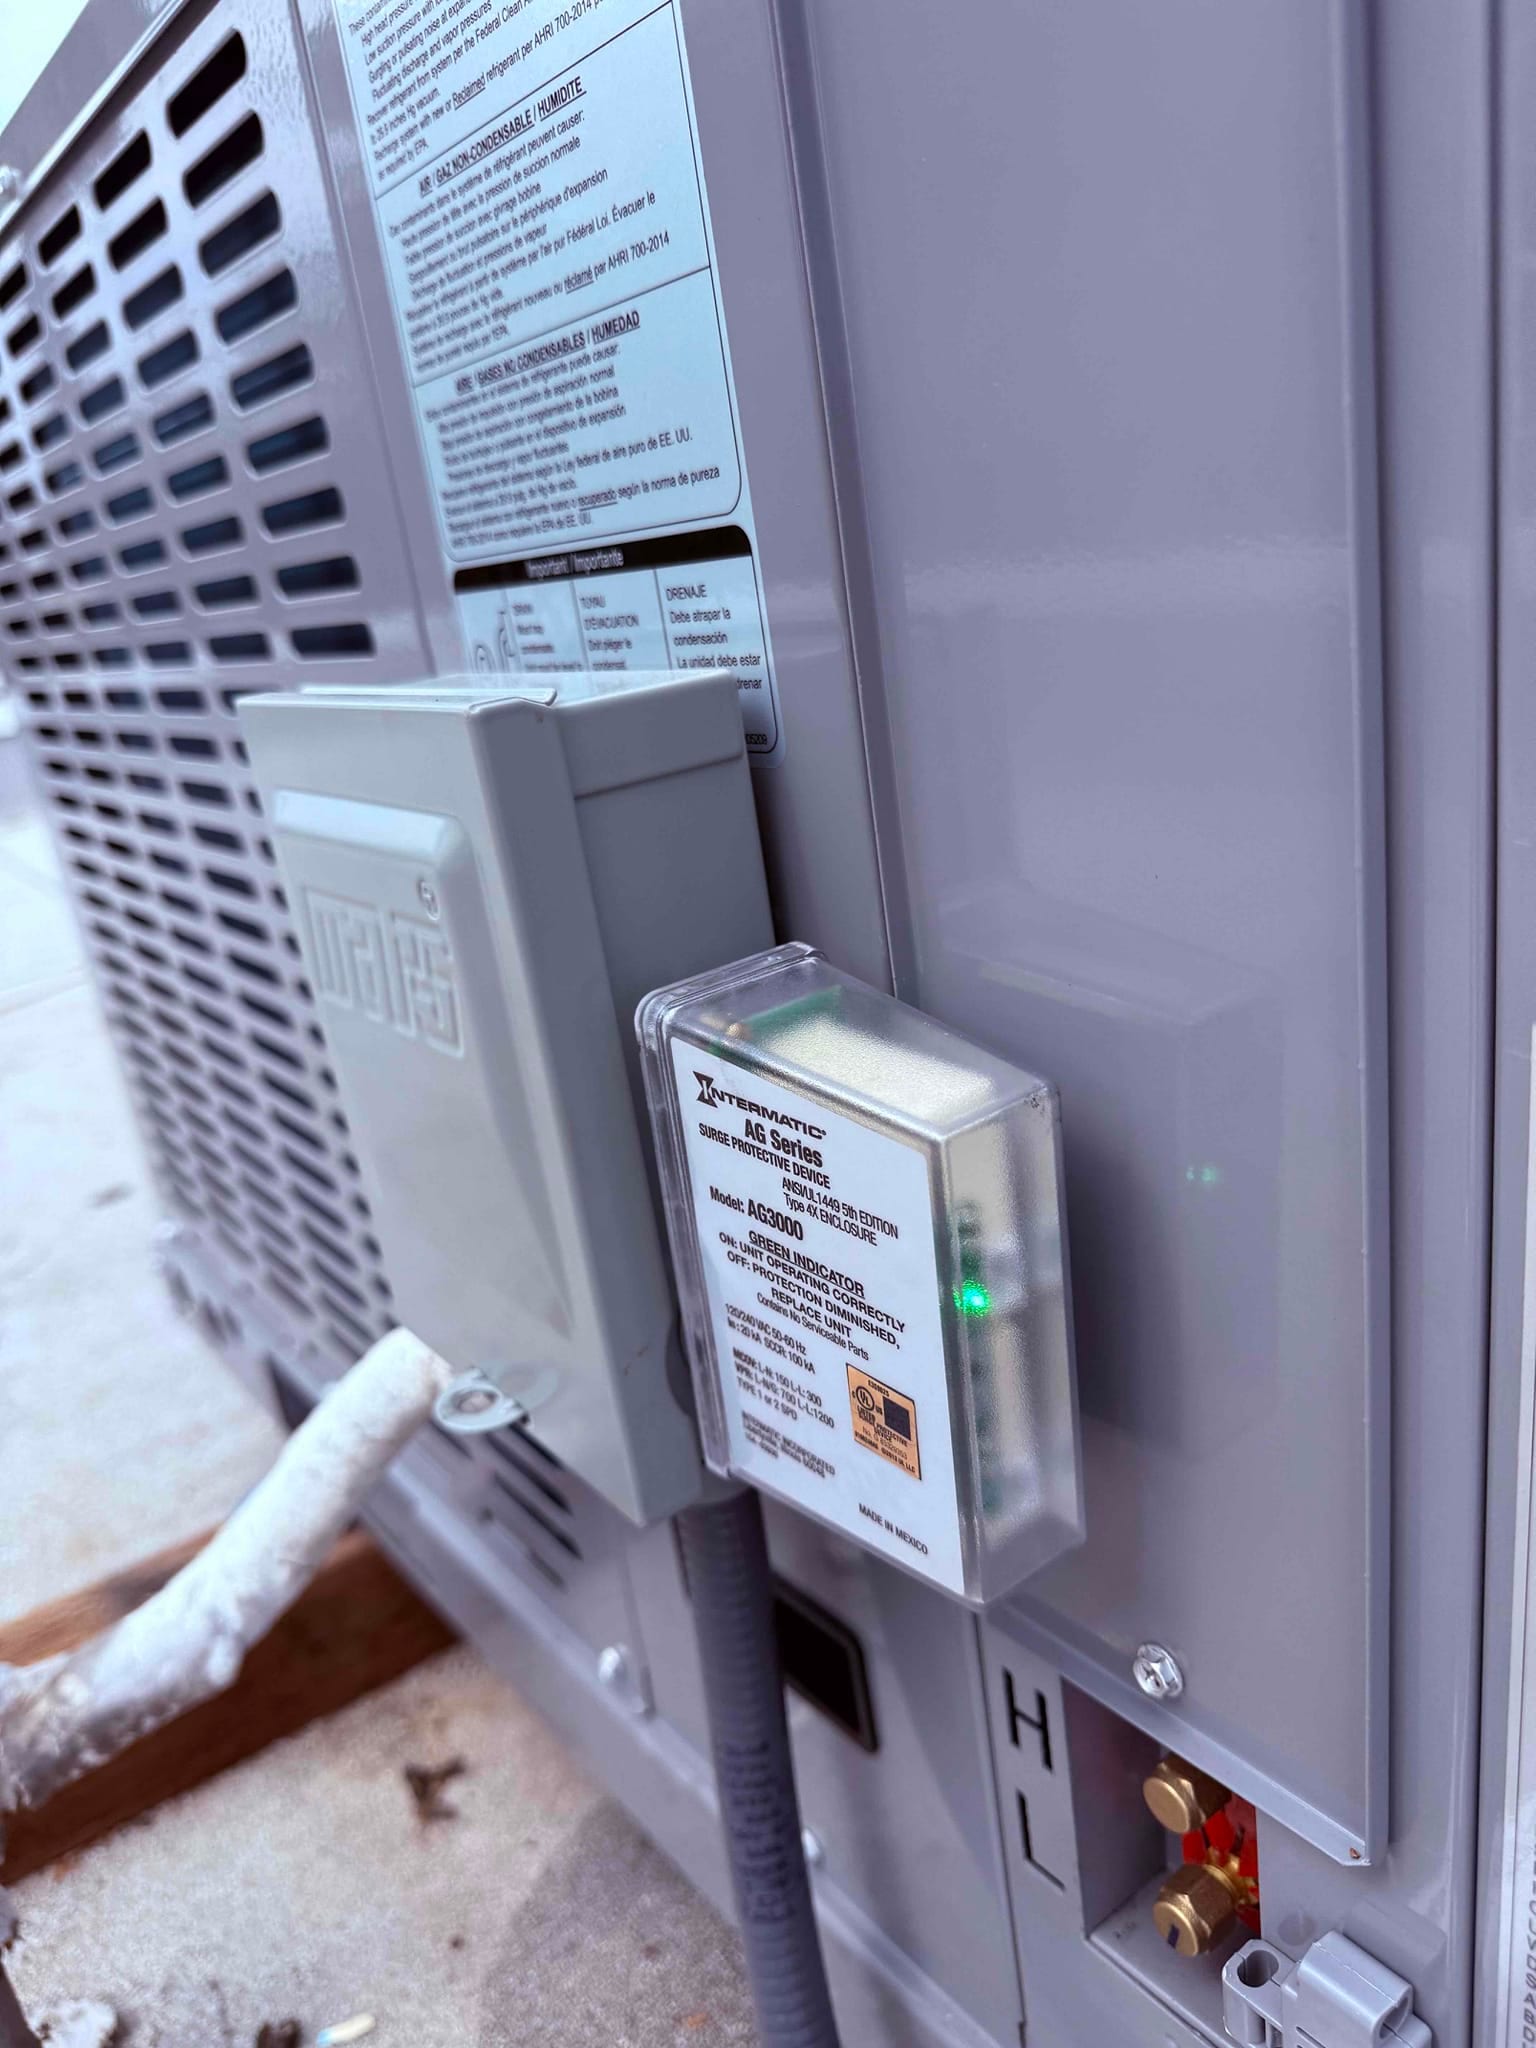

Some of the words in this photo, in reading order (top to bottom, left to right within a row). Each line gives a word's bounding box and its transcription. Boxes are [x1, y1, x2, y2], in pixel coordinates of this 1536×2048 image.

[376, 33, 396, 55] suction
[396, 11, 421, 41] pressure
[391, 53, 397, 65] or
[398, 32, 423, 62] pulsating
[423, 18, 440, 38] noise
[440, 9, 448, 24] at
[401, 50, 428, 78] discharge
[429, 37, 441, 56] and
[441, 25, 458, 46] vapor
[460, 0, 491, 34] pressures
[416, 71, 430, 87] from
[430, 54, 452, 78] system
[452, 44, 463, 63] per
[463, 36, 475, 52] the
[475, 13, 501, 42] Federal
[501, 0, 522, 22] Clean
[432, 106, 444, 119] new
[445, 99, 451, 112] or
[452, 72, 485, 108] Reclaimed
[486, 48, 520, 81] refrigerant
[521, 39, 532, 60] per
[534, 22, 554, 48] AHRI
[554, 0, 591, 31] 700-2014
[436, 162, 452, 183] GAZ
[452, 110, 531, 171] NON-CONDENSABLE
[533, 104, 536, 121] /
[537, 76, 582, 118] HUMIDITE
[483, 167, 492, 180] de
[527, 125, 556, 156] peuvent
[556, 110, 584, 135] causer:
[485, 177, 512, 202] pression
[513, 171, 522, 184] de
[522, 155, 549, 178] succion
[550, 136, 580, 161] normale
[517, 183, 541, 203] bobine
[500, 221, 511, 235] sur
[511, 216, 518, 228] le
[563, 169, 607, 200] d'expansion
[527, 250, 538, 265] par
[553, 236, 565, 253] pur
[566, 219, 595, 243] Fédéral
[595, 212, 610, 230] Loi.
[611, 197, 644, 222] Évacuer
[646, 191, 655, 205] le
[514, 236, 523, 249] de
[523, 224, 546, 243] vapeur
[553, 282, 563, 294] ou
[593, 262, 606, 280] par
[608, 249, 629, 270] AHRI
[630, 231, 669, 259] 700-2014
[517, 332, 584, 369] CONDENSABLES
[586, 328, 590, 344] /
[591, 311, 639, 342] HUMEDAD
[584, 394, 592, 405] la
[592, 386, 618, 403] bobina
[589, 365, 614, 382] normal
[601, 449, 611, 462] de
[612, 446, 626, 459] aire
[628, 441, 646, 457] puro
[647, 437, 657, 450] de
[658, 432, 673, 447] EE.
[675, 427, 692, 443] UU.
[641, 480, 649, 492] la
[651, 476, 676, 490] norma
[677, 472, 688, 485] de
[690, 467, 719, 485] pureza
[666, 584, 706, 600] DRENAJE
[669, 611, 690, 623] Debe
[692, 610, 720, 623] atrapar
[722, 607, 731, 619] la
[674, 632, 727, 645] condensación
[677, 658, 688, 668] La
[689, 655, 715, 667] unidad
[717, 654, 737, 667] debe
[739, 654, 760, 666] estar
[693, 1071, 825, 1140] INTERMATIC
[698, 1123, 730, 1146] SURGE
[731, 1136, 790, 1172] PROTECTIVE
[792, 1161, 830, 1189] DEVICE
[744, 1118, 766, 1144] AG
[770, 1129, 822, 1167] Series
[709, 1186, 744, 1213] Model:
[748, 1199, 803, 1240] AG3000
[783, 1192, 805, 1212] Type
[806, 1203, 819, 1219] 4X
[819, 1208, 876, 1245] ENCLOSURE
[841, 1202, 857, 1221] 5th
[859, 1210, 898, 1238] EDITION
[719, 1232, 737, 1248] ON:
[739, 1241, 763, 1261] UNIT
[766, 1255, 829, 1294] OPERATING
[832, 1288, 904, 1332] CORRECTLY
[748, 1230, 790, 1262] GREEN
[793, 1251, 864, 1298] INDICATOR
[727, 1250, 750, 1269] OFF:
[752, 1262, 822, 1306] PROTECTION
[825, 1300, 899, 1348] DIMINISHED,
[771, 1287, 821, 1322] REPLACE
[824, 1315, 851, 1337] UNIT
[757, 1292, 788, 1317] Contains
[789, 1309, 800, 1323] No
[801, 1316, 846, 1348] Serviceable
[847, 1340, 868, 1360] Parts
[795, 1340, 806, 1355] Hz
[788, 1351, 803, 1367] 100
[803, 1359, 815, 1374] kA
[790, 1380, 805, 1398] L-L:
[757, 1389, 762, 1399] 1
[773, 1398, 779, 1410] 2
[858, 1503, 882, 1526] MADE
[884, 1519, 893, 1533] IN
[895, 1526, 928, 1554] MEXICO
[1002, 1665, 1053, 1773] H
[1017, 1788, 1066, 1890] L
